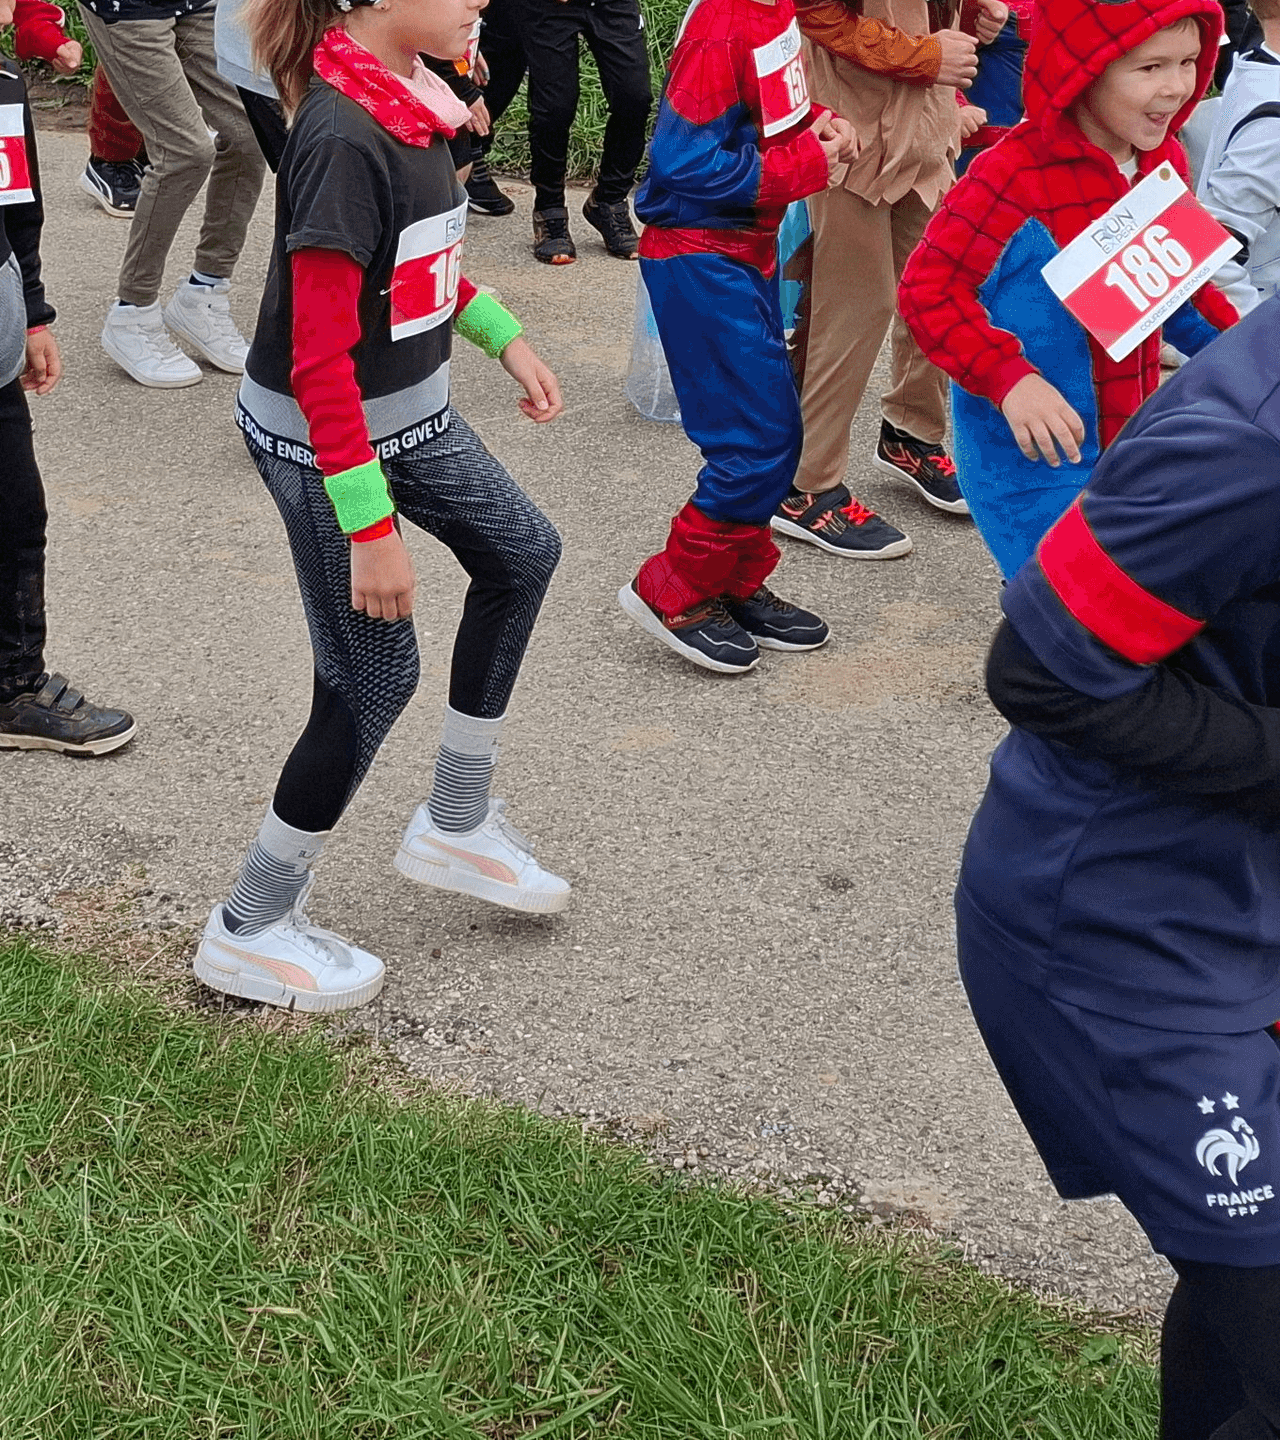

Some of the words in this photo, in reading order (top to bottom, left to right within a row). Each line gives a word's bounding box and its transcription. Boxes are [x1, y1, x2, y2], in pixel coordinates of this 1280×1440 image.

[1091, 207, 1134, 248] RUN
[1102, 220, 1138, 255] EXPERT
[1104, 225, 1193, 312] 186
[1140, 309, 1167, 332] COURSE
[1178, 289, 1186, 297] 2
[1184, 267, 1210, 290] ETANGS
[245, 415, 274, 453] SOME
[277, 440, 314, 468] ENER
[401, 421, 434, 449] GIVE
[434, 410, 450, 433] UP
[1206, 1184, 1275, 1207] FRANCE
